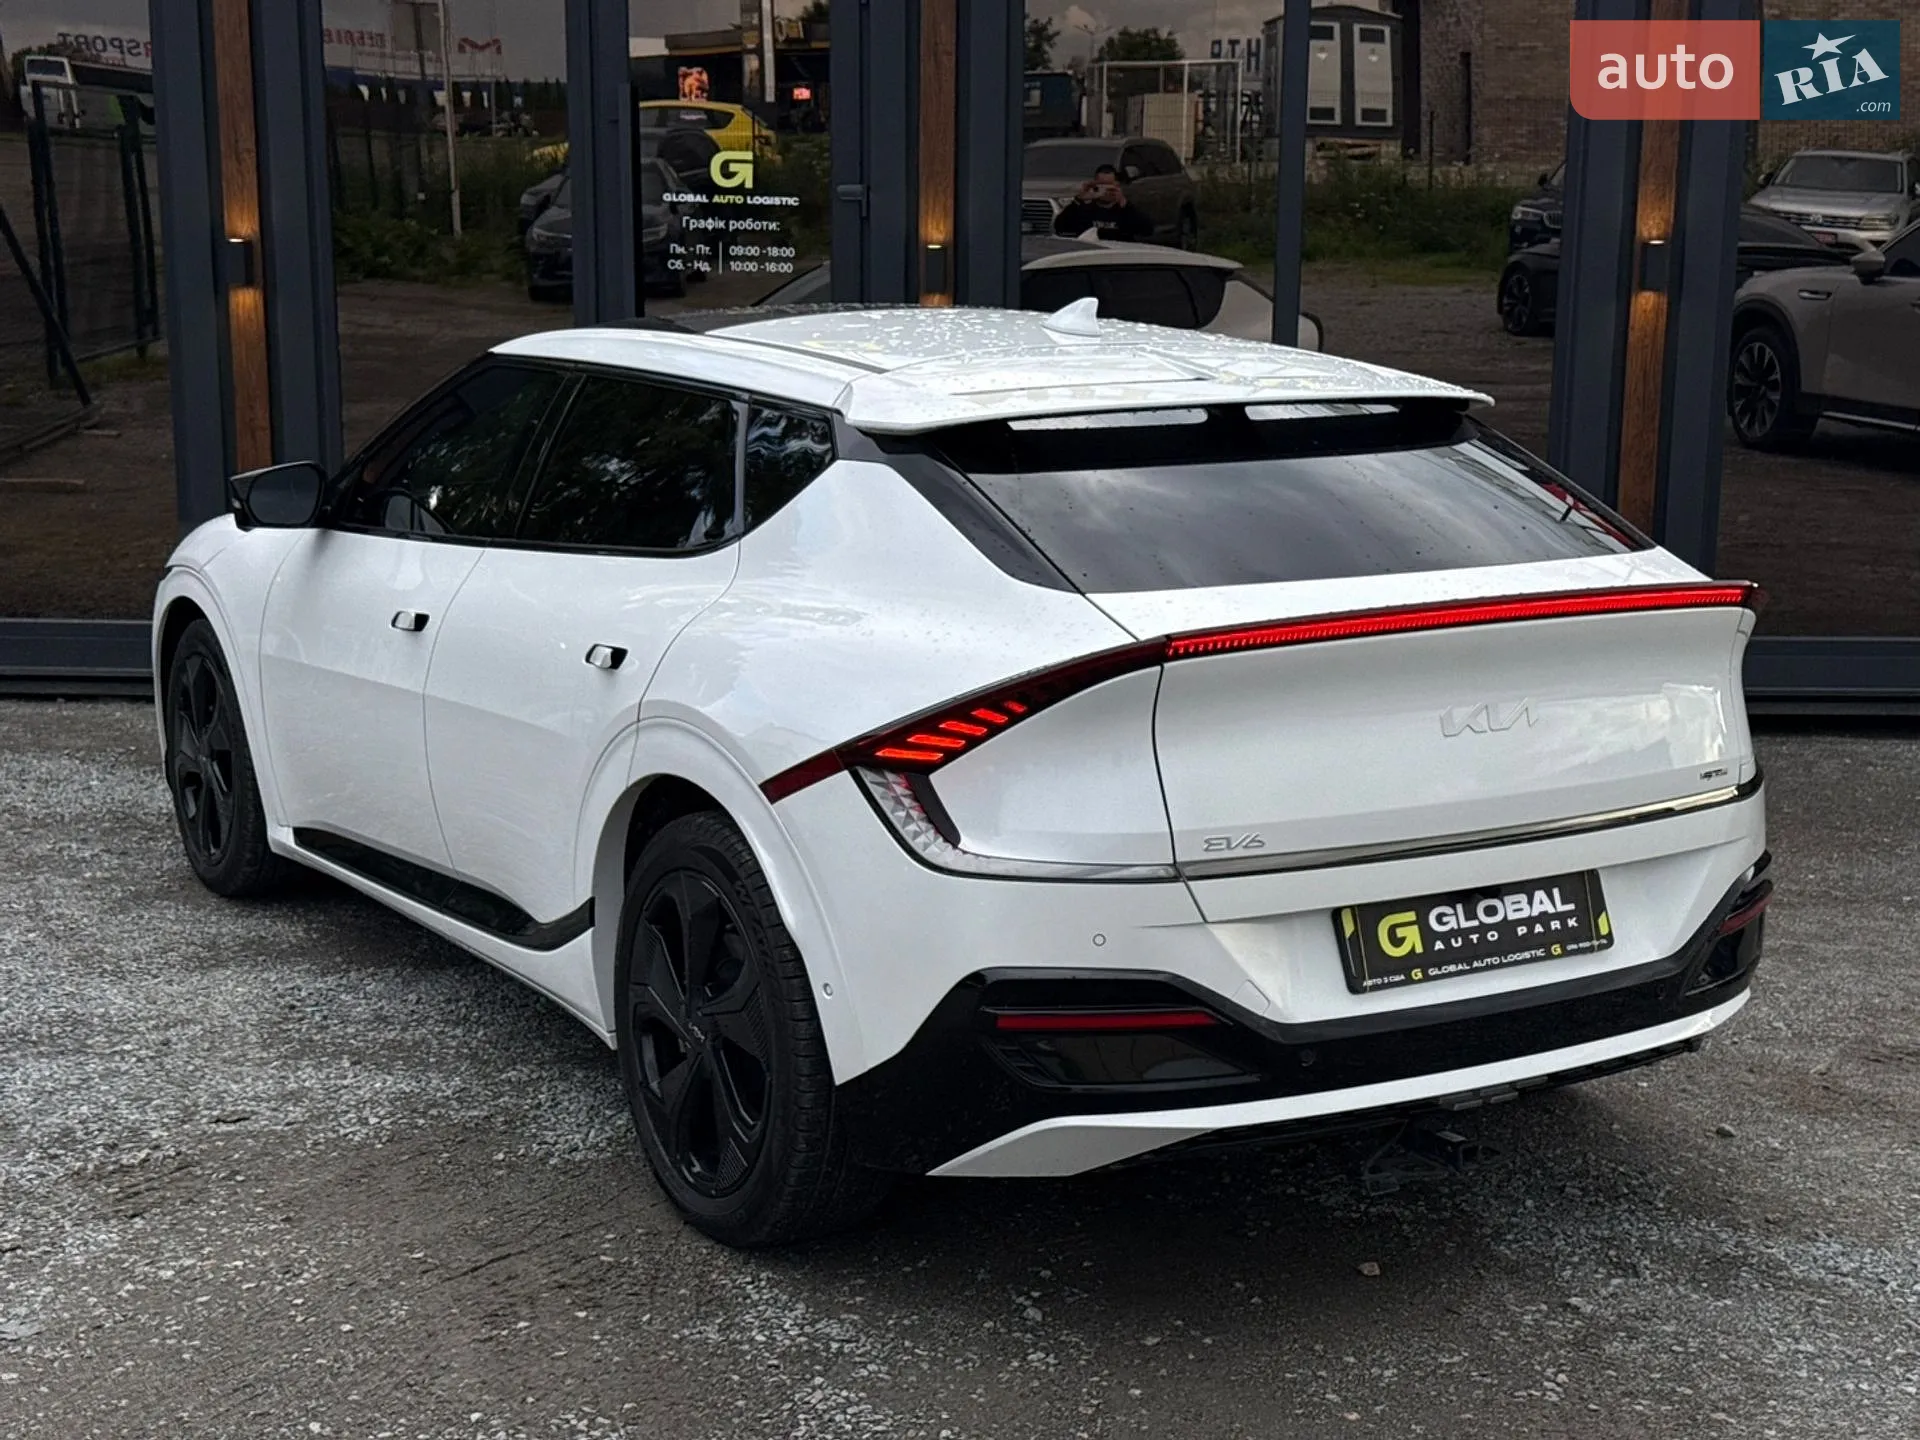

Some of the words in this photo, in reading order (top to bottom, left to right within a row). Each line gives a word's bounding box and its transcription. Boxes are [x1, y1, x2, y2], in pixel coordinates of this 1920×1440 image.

[662, 192, 709, 203] GLOBAL
[712, 194, 744, 204] AUTO
[746, 195, 800, 206] LOGISTIC
[682, 215, 727, 232] Графік
[729, 218, 781, 232] роботи:
[669, 243, 687, 254] Пн.
[696, 244, 712, 255] Пт.
[729, 245, 760, 257] 09:00
[730, 260, 759, 272] 10:00
[1440, 697, 1539, 738] KIA
[1203, 832, 1267, 852] EV6
[1428, 887, 1576, 932] GLOBAL
[1434, 931, 1499, 951] AUTO
[1516, 917, 1579, 937] PARK
[1428, 962, 1470, 976] GLOBAL
[1472, 956, 1500, 968] AUTO
[1501, 948, 1546, 963] LOGISTIC
